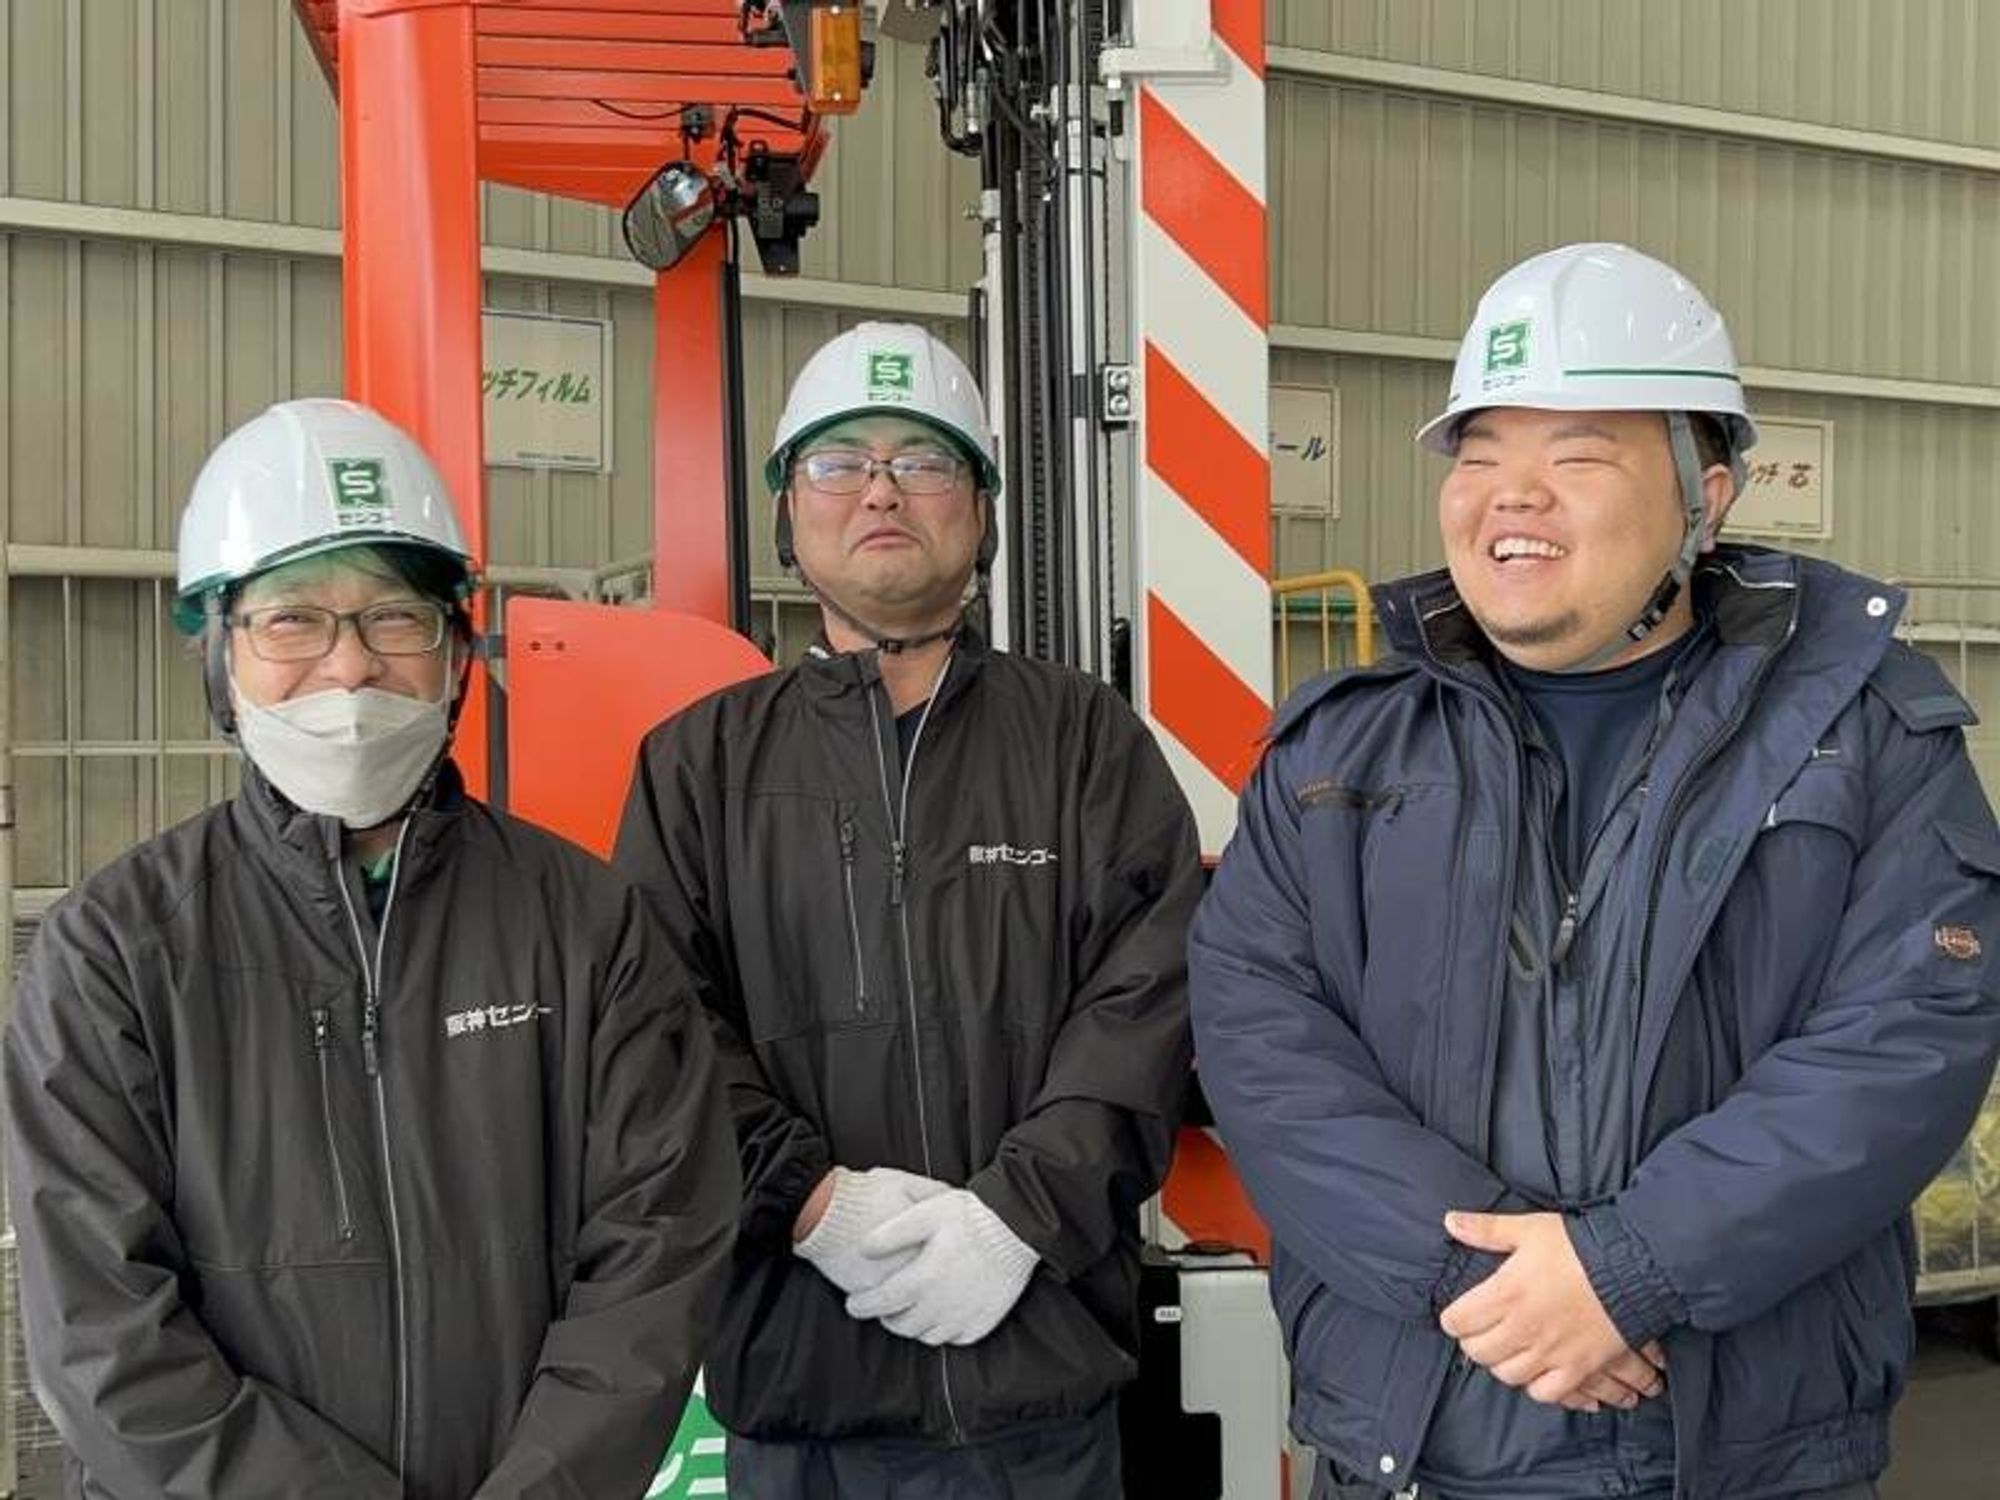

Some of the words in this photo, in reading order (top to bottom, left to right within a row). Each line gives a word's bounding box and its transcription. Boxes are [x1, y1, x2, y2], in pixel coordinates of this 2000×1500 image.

[1269, 431, 1326, 461] ール
[1746, 461, 1780, 485] ッチ
[969, 843, 1058, 865] 阪神センコー
[445, 1002, 553, 1037] 阪神センー
